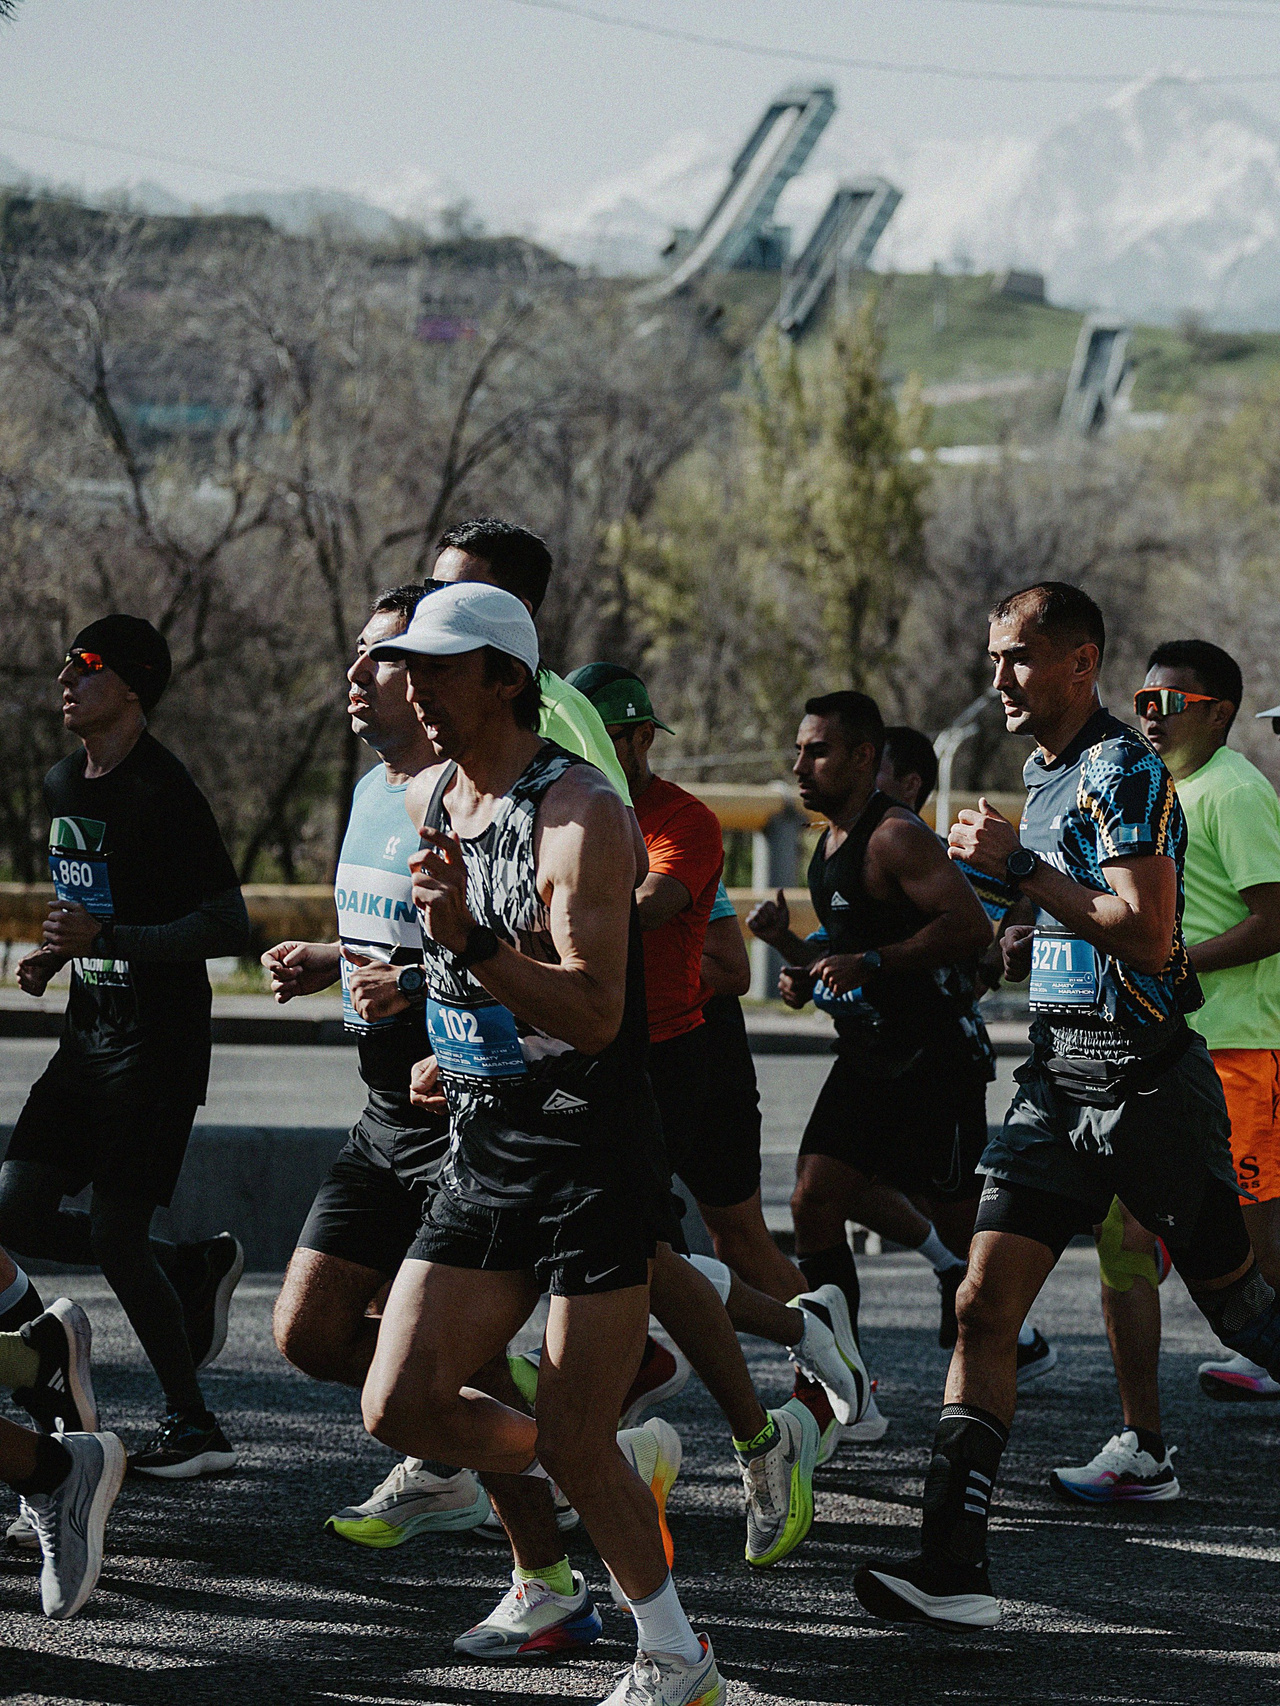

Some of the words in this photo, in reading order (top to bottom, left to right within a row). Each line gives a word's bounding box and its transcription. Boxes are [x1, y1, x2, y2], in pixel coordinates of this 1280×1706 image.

[59, 859, 93, 888] 860
[336, 888, 418, 924] DAIKIN
[1032, 940, 1073, 971] 3271
[439, 1007, 484, 1043] 102
[481, 1059, 524, 1068] MARATHON
